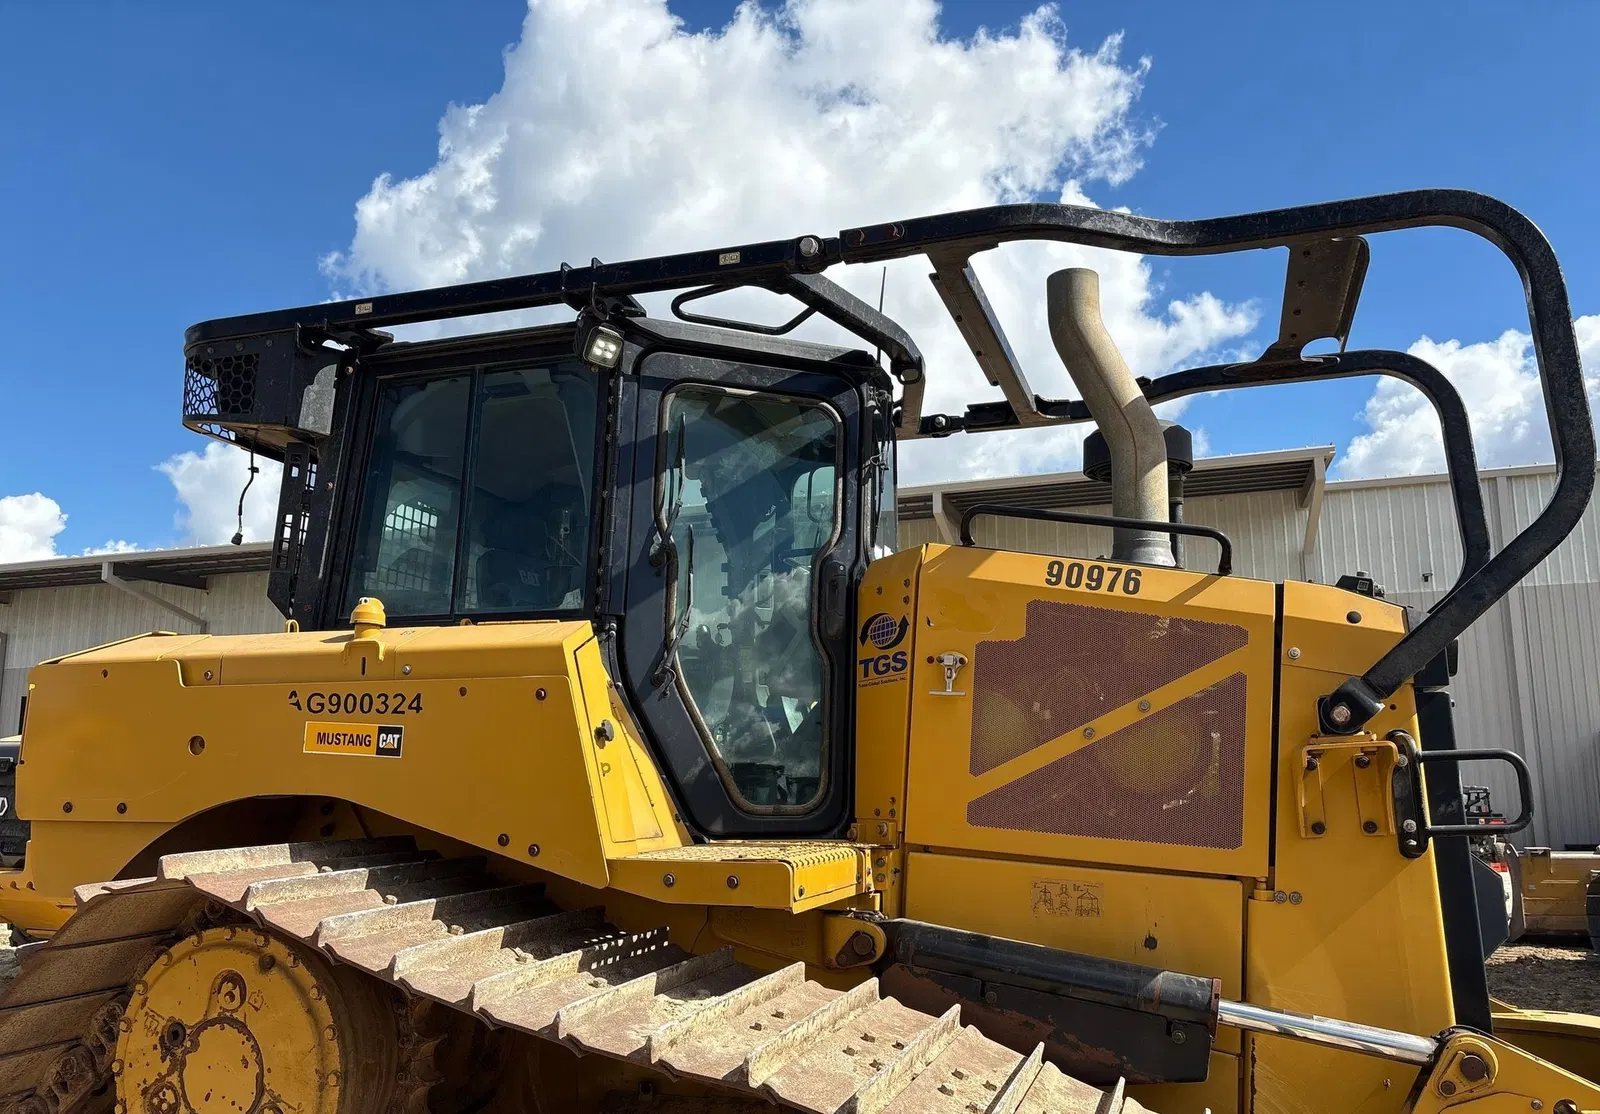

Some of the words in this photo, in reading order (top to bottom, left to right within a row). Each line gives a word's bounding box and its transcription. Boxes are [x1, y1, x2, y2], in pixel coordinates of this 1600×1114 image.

[1044, 560, 1142, 596] 90976
[859, 651, 908, 678] TGS
[288, 690, 423, 715] AG900324
[316, 731, 372, 747] MUSTANG
[378, 733, 400, 749] CAT
